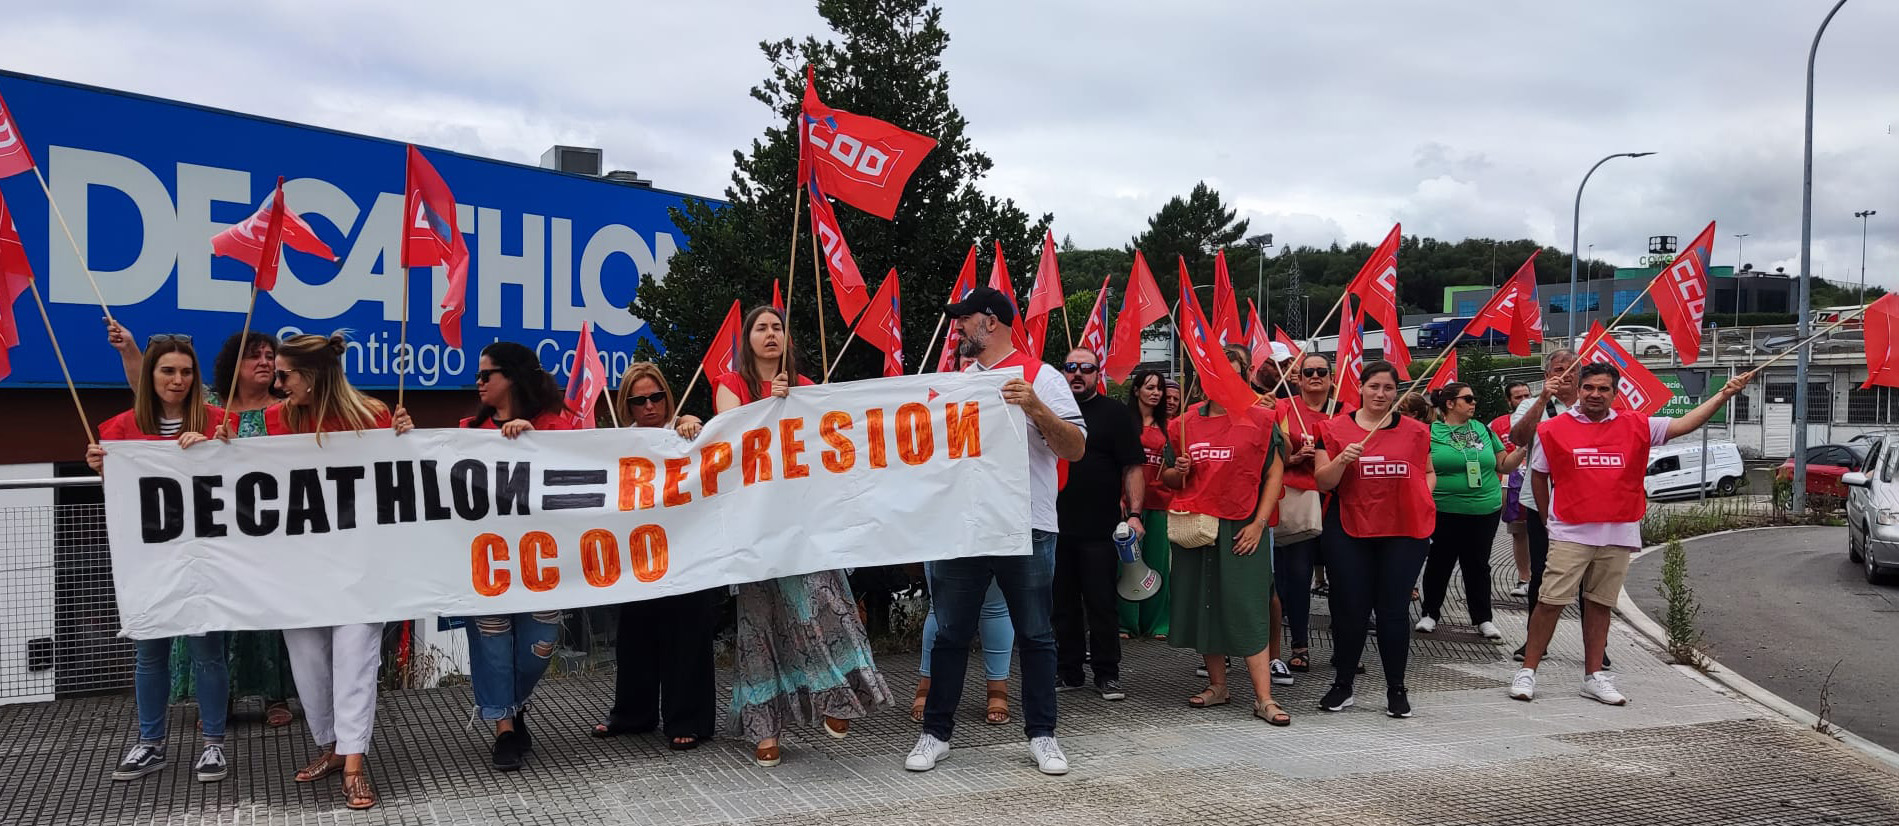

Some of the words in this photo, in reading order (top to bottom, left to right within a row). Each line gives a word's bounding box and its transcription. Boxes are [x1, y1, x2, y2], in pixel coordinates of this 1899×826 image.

[1191, 449, 1231, 461] CCOO
[1577, 455, 1622, 466] CCOO
[1363, 463, 1408, 476] CCOO
